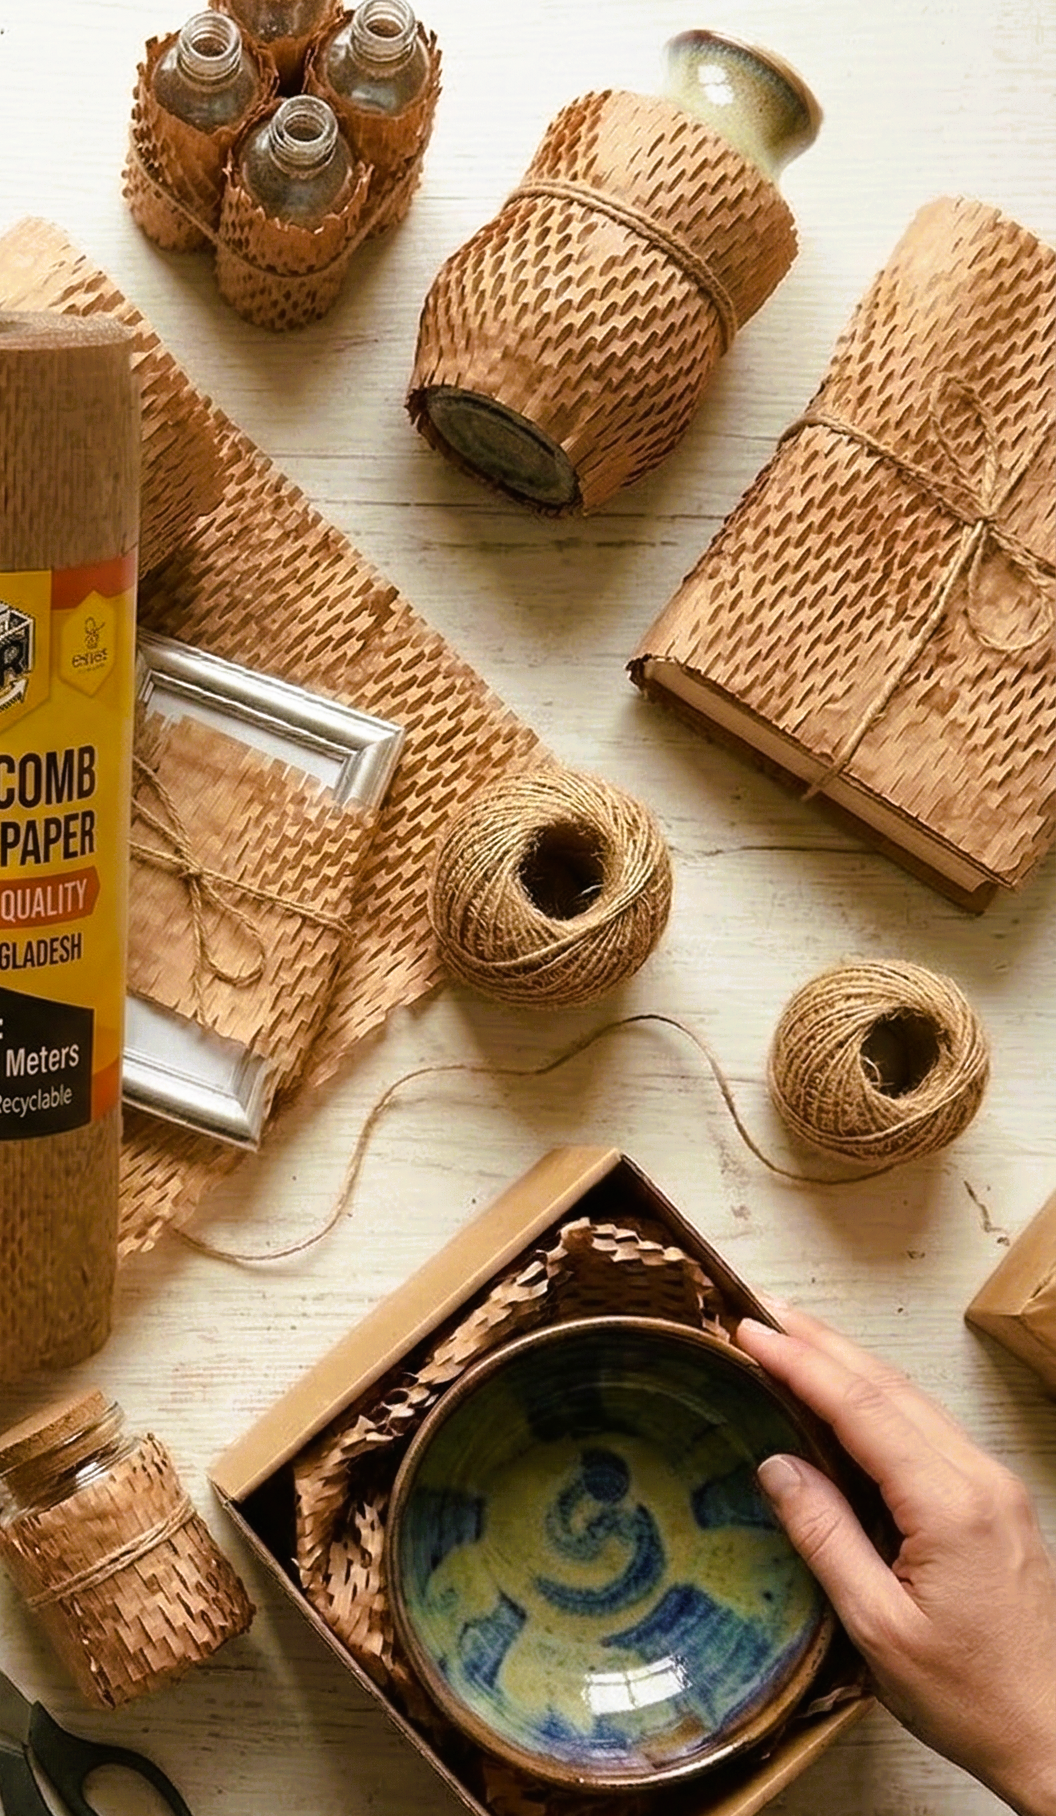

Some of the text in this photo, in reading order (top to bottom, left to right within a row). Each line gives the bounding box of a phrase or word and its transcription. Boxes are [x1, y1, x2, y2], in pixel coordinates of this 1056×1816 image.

[0, 810, 95, 868] PAPER
[1, 878, 87, 923] QUALITY
[6, 1043, 79, 1078] Meters
